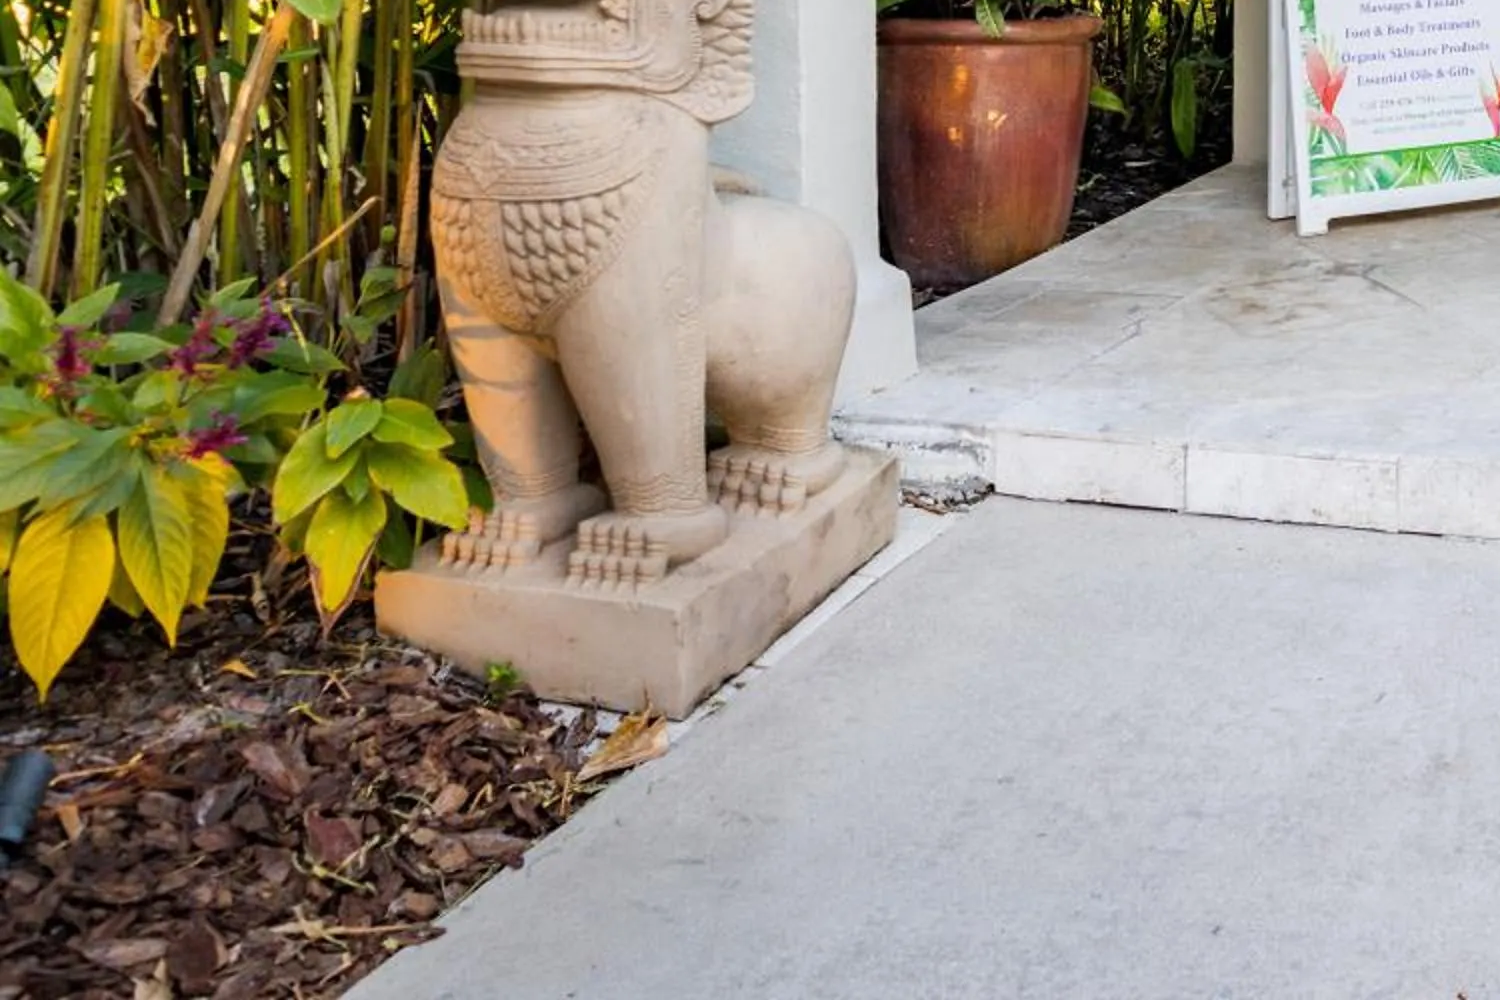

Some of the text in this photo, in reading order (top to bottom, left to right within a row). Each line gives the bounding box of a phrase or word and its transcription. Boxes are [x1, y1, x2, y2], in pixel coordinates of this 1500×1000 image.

[1360, 1, 1412, 14] Massages
[1414, 0, 1424, 10] &
[1344, 18, 1482, 40] Foot & Body Treatments
[1341, 42, 1491, 65] Organic Skincare Products
[1356, 65, 1476, 87] Essential Oils & Gifts
